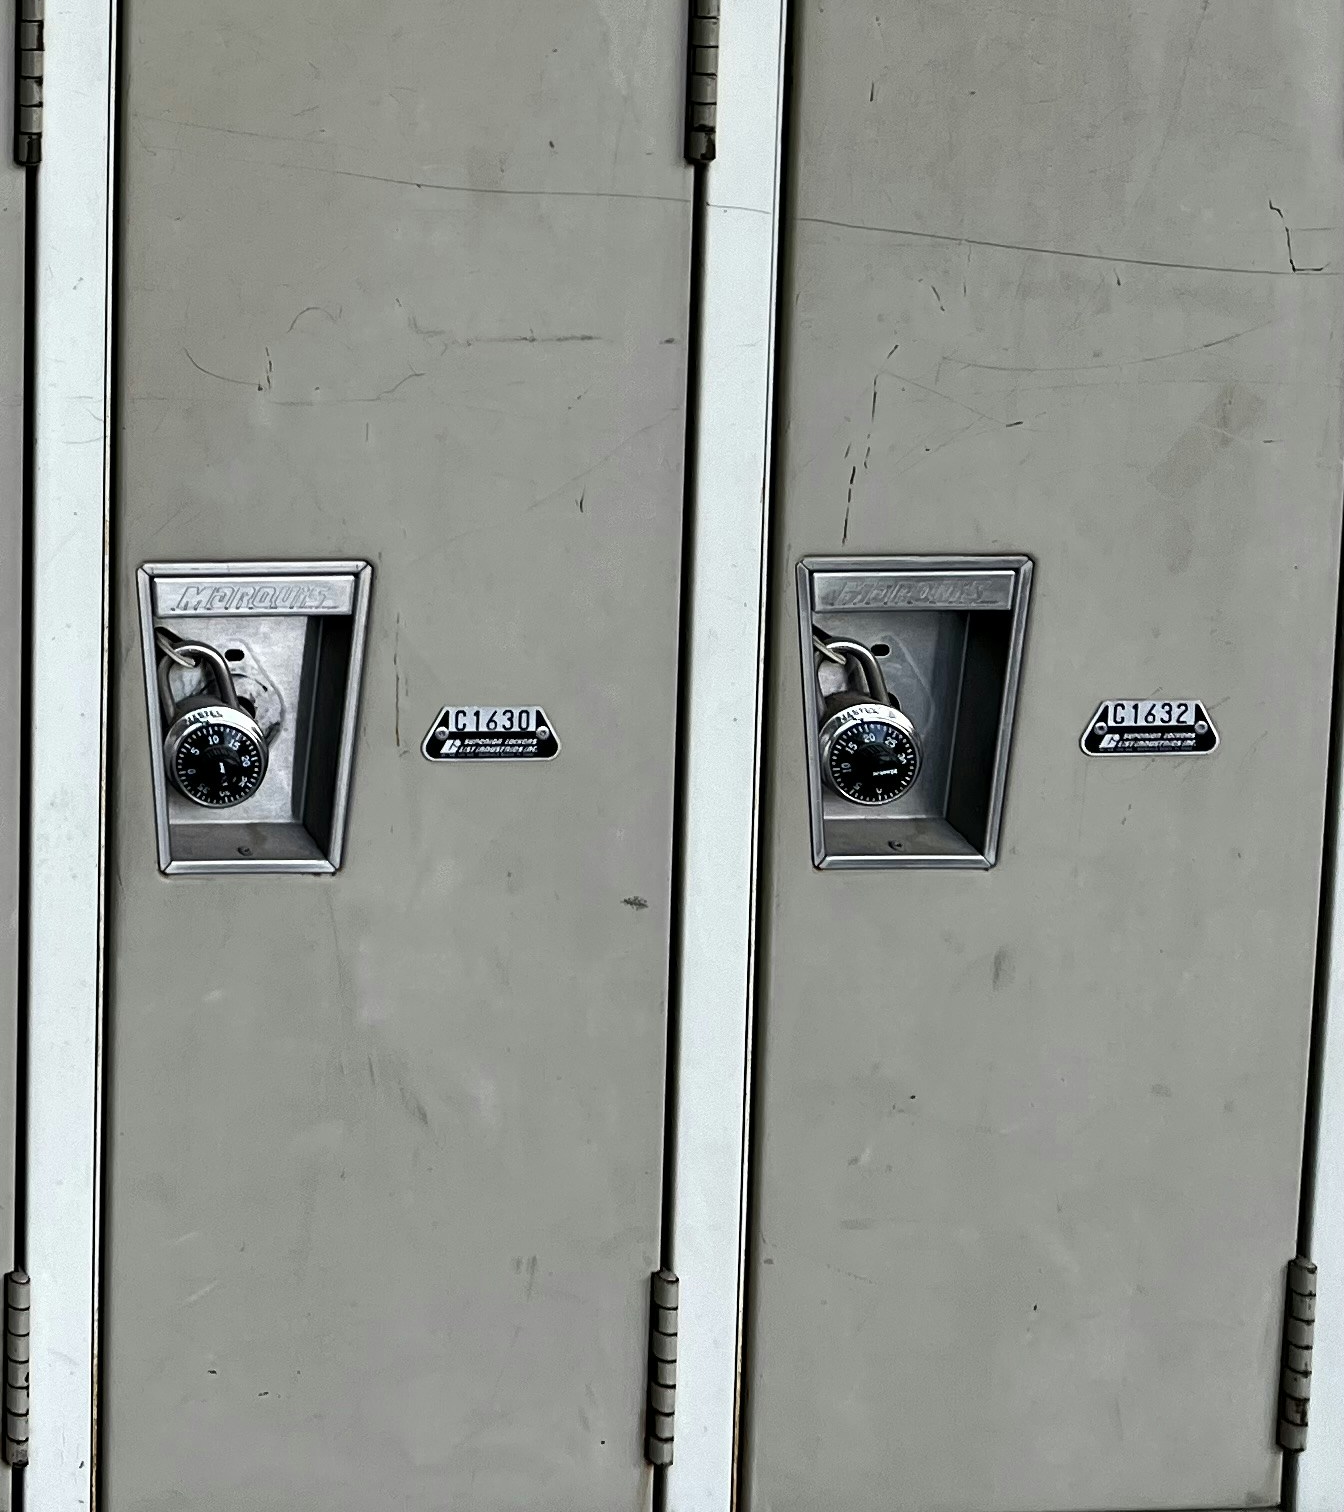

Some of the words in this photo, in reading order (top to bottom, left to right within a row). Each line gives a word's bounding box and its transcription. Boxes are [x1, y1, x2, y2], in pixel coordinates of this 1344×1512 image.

[1114, 703, 1188, 724] C1632
[455, 710, 529, 731] C1630
[209, 735, 219, 745] 10
[864, 734, 875, 742] 20
[885, 737, 897, 748] 25
[229, 738, 241, 750] 15
[846, 741, 857, 754] 15
[192, 748, 200, 756] 5
[241, 756, 251, 767] 20
[841, 762, 852, 772] 10
